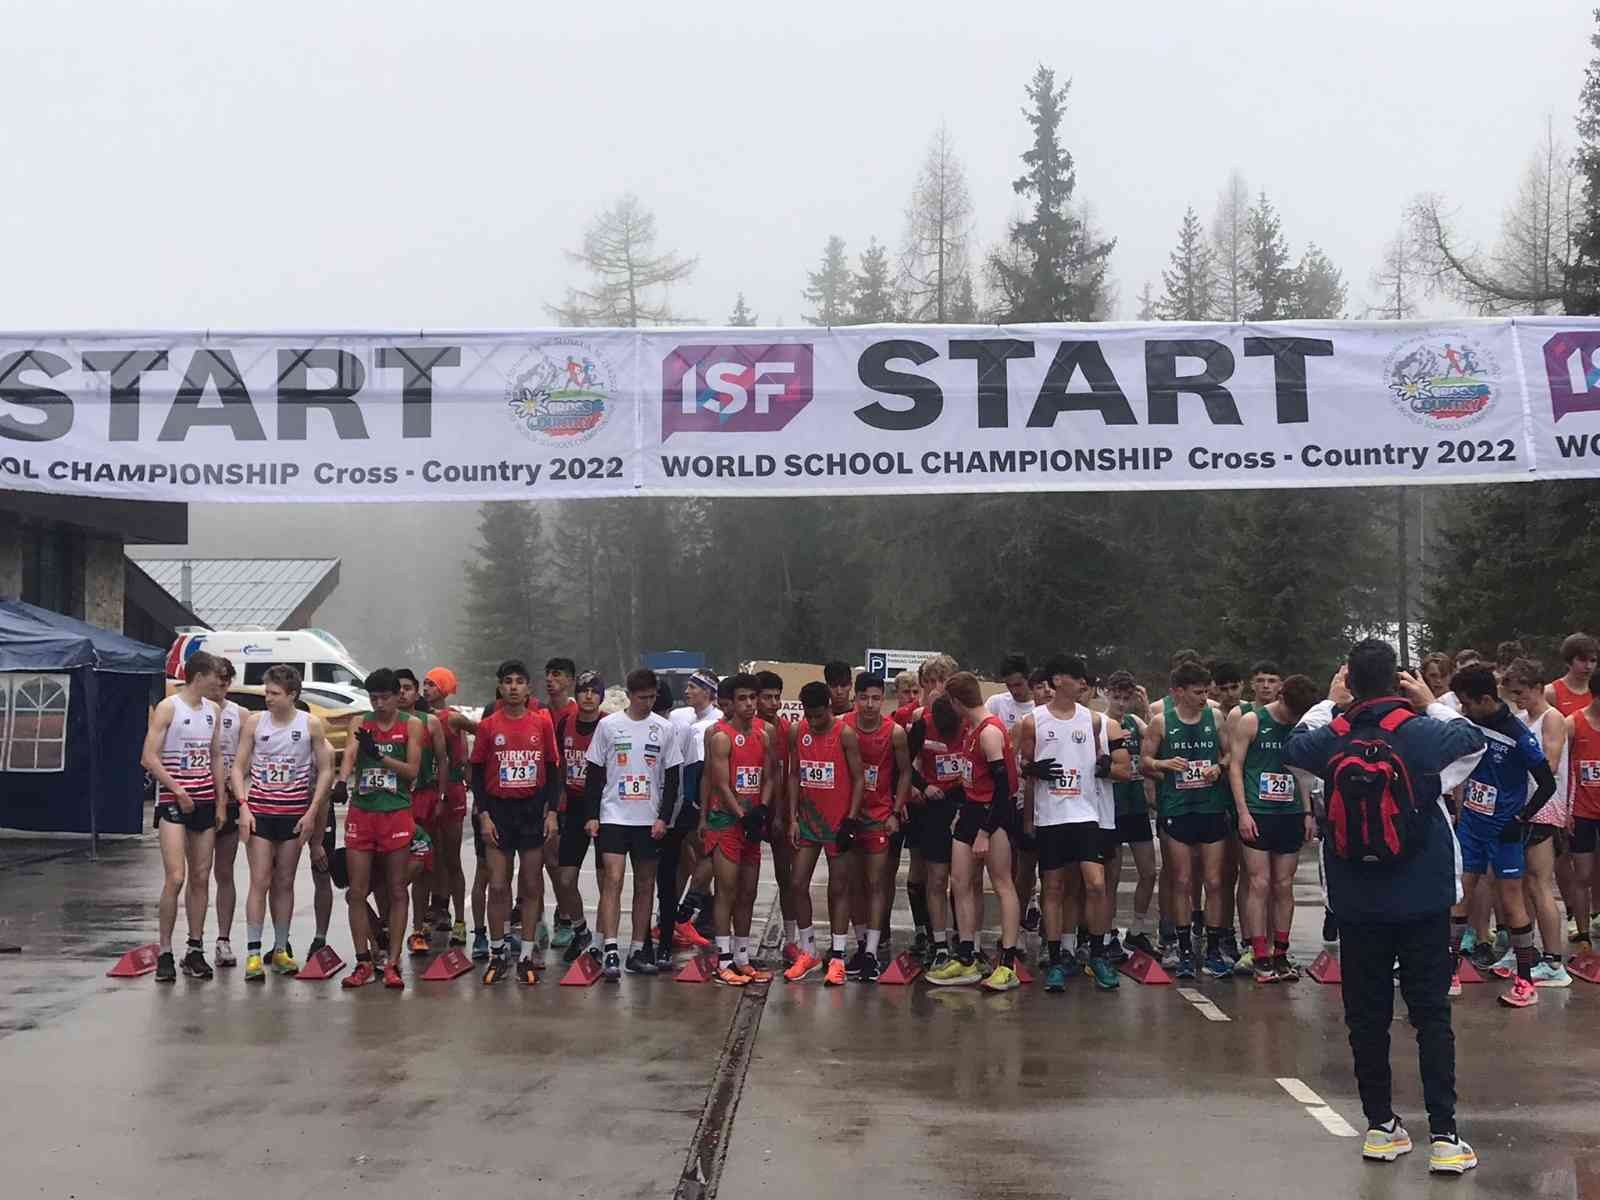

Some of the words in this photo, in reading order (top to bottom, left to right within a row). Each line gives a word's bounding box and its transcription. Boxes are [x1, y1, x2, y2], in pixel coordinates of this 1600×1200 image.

[682, 361, 795, 414] ISF
[854, 337, 1333, 430] START
[0, 347, 460, 442] START
[661, 455, 776, 478] WORLD
[784, 452, 913, 476] SCHOOL
[921, 447, 1172, 474] CHAMPIONSHIP
[1189, 447, 1275, 469] Cross
[1301, 444, 1428, 470] Country
[1437, 439, 1516, 463] 2022
[48, 461, 298, 484] CHAMPIONSHIP
[315, 463, 397, 484] Cross
[423, 460, 541, 486] Country
[549, 457, 623, 480] 2022
[1170, 741, 1214, 750] IRELAND
[190, 756, 205, 767] 22
[270, 770, 284, 782] 21
[511, 767, 526, 779] 73
[809, 768, 823, 780] 49
[1187, 768, 1200, 780] 34
[1592, 768, 1600, 779] 5
[369, 775, 385, 788] 45
[747, 774, 758, 786] 50
[1059, 775, 1074, 788] 67
[632, 781, 640, 793] 8
[1272, 780, 1287, 793] 29
[1471, 788, 1485, 803] 38
